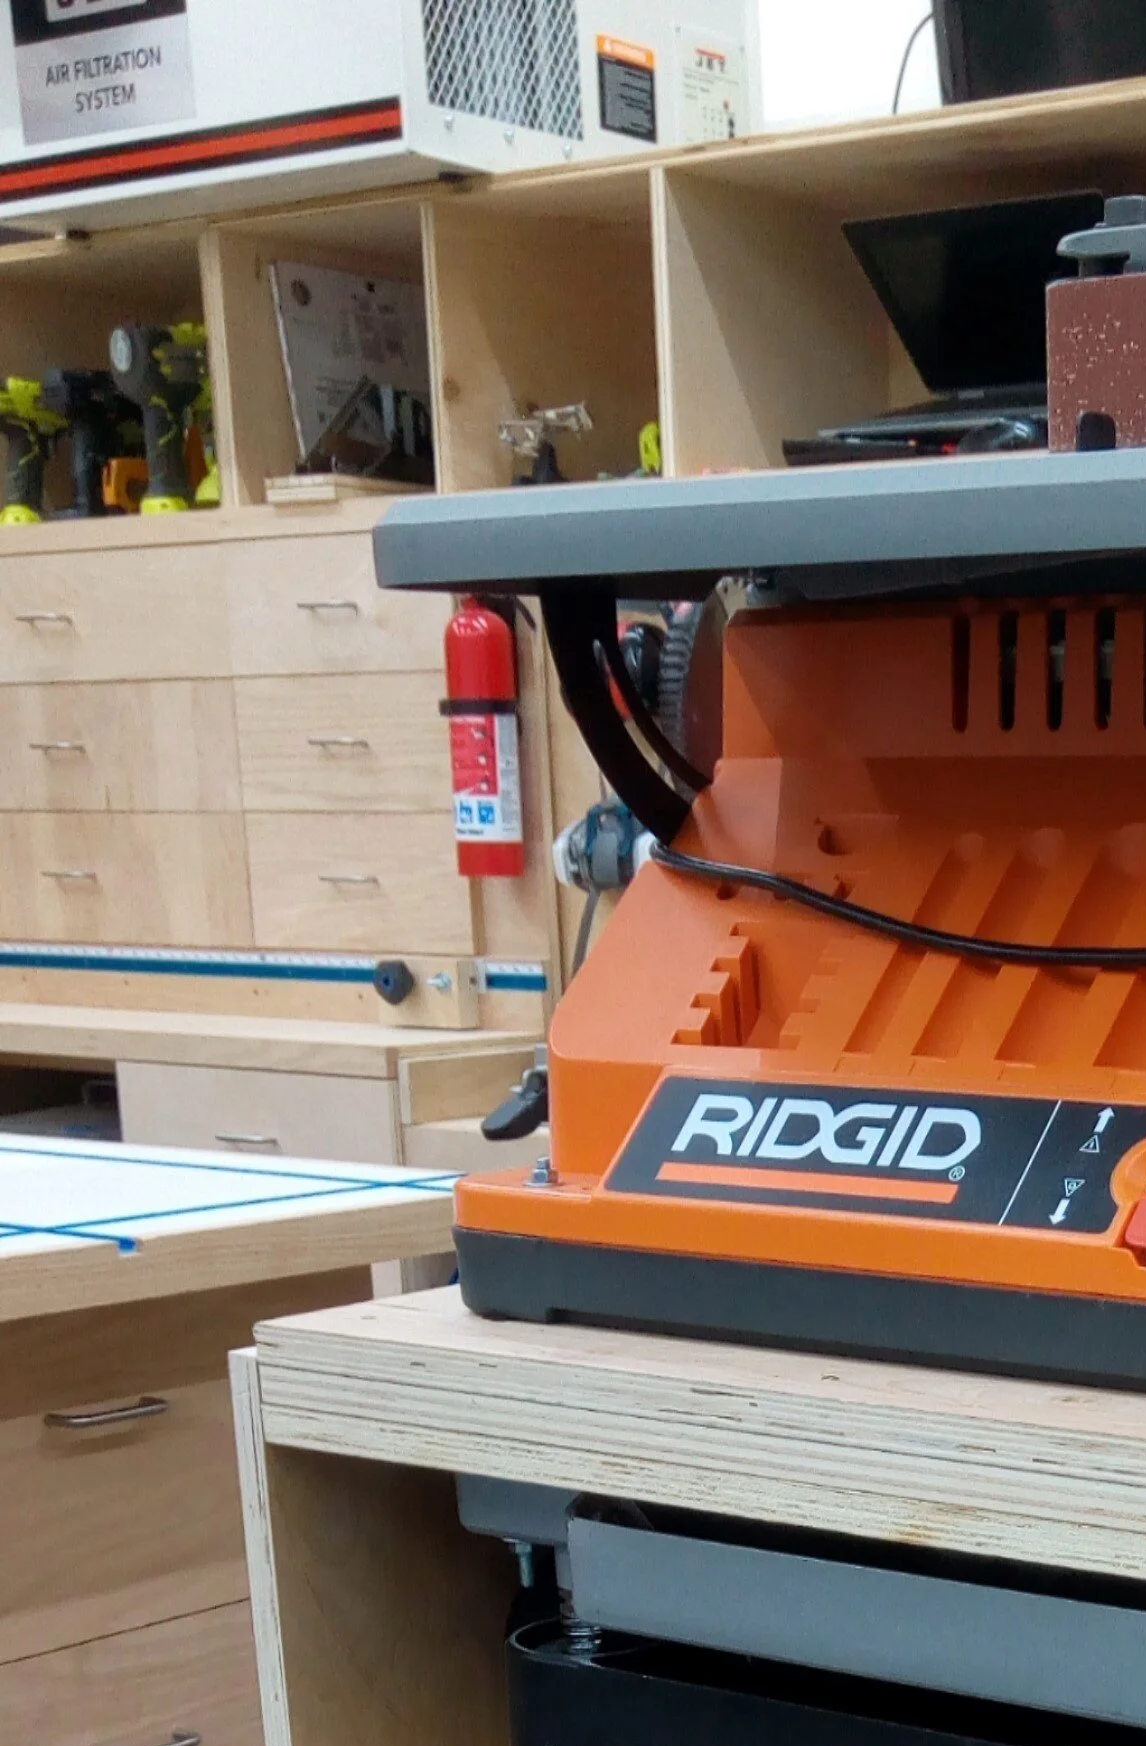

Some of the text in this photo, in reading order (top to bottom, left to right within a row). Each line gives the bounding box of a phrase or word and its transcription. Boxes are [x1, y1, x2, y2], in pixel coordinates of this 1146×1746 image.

[46, 46, 162, 87] AIR FILTRATION
[75, 83, 136, 113] SYSTEM
[671, 1093, 982, 1171] RIDGID
